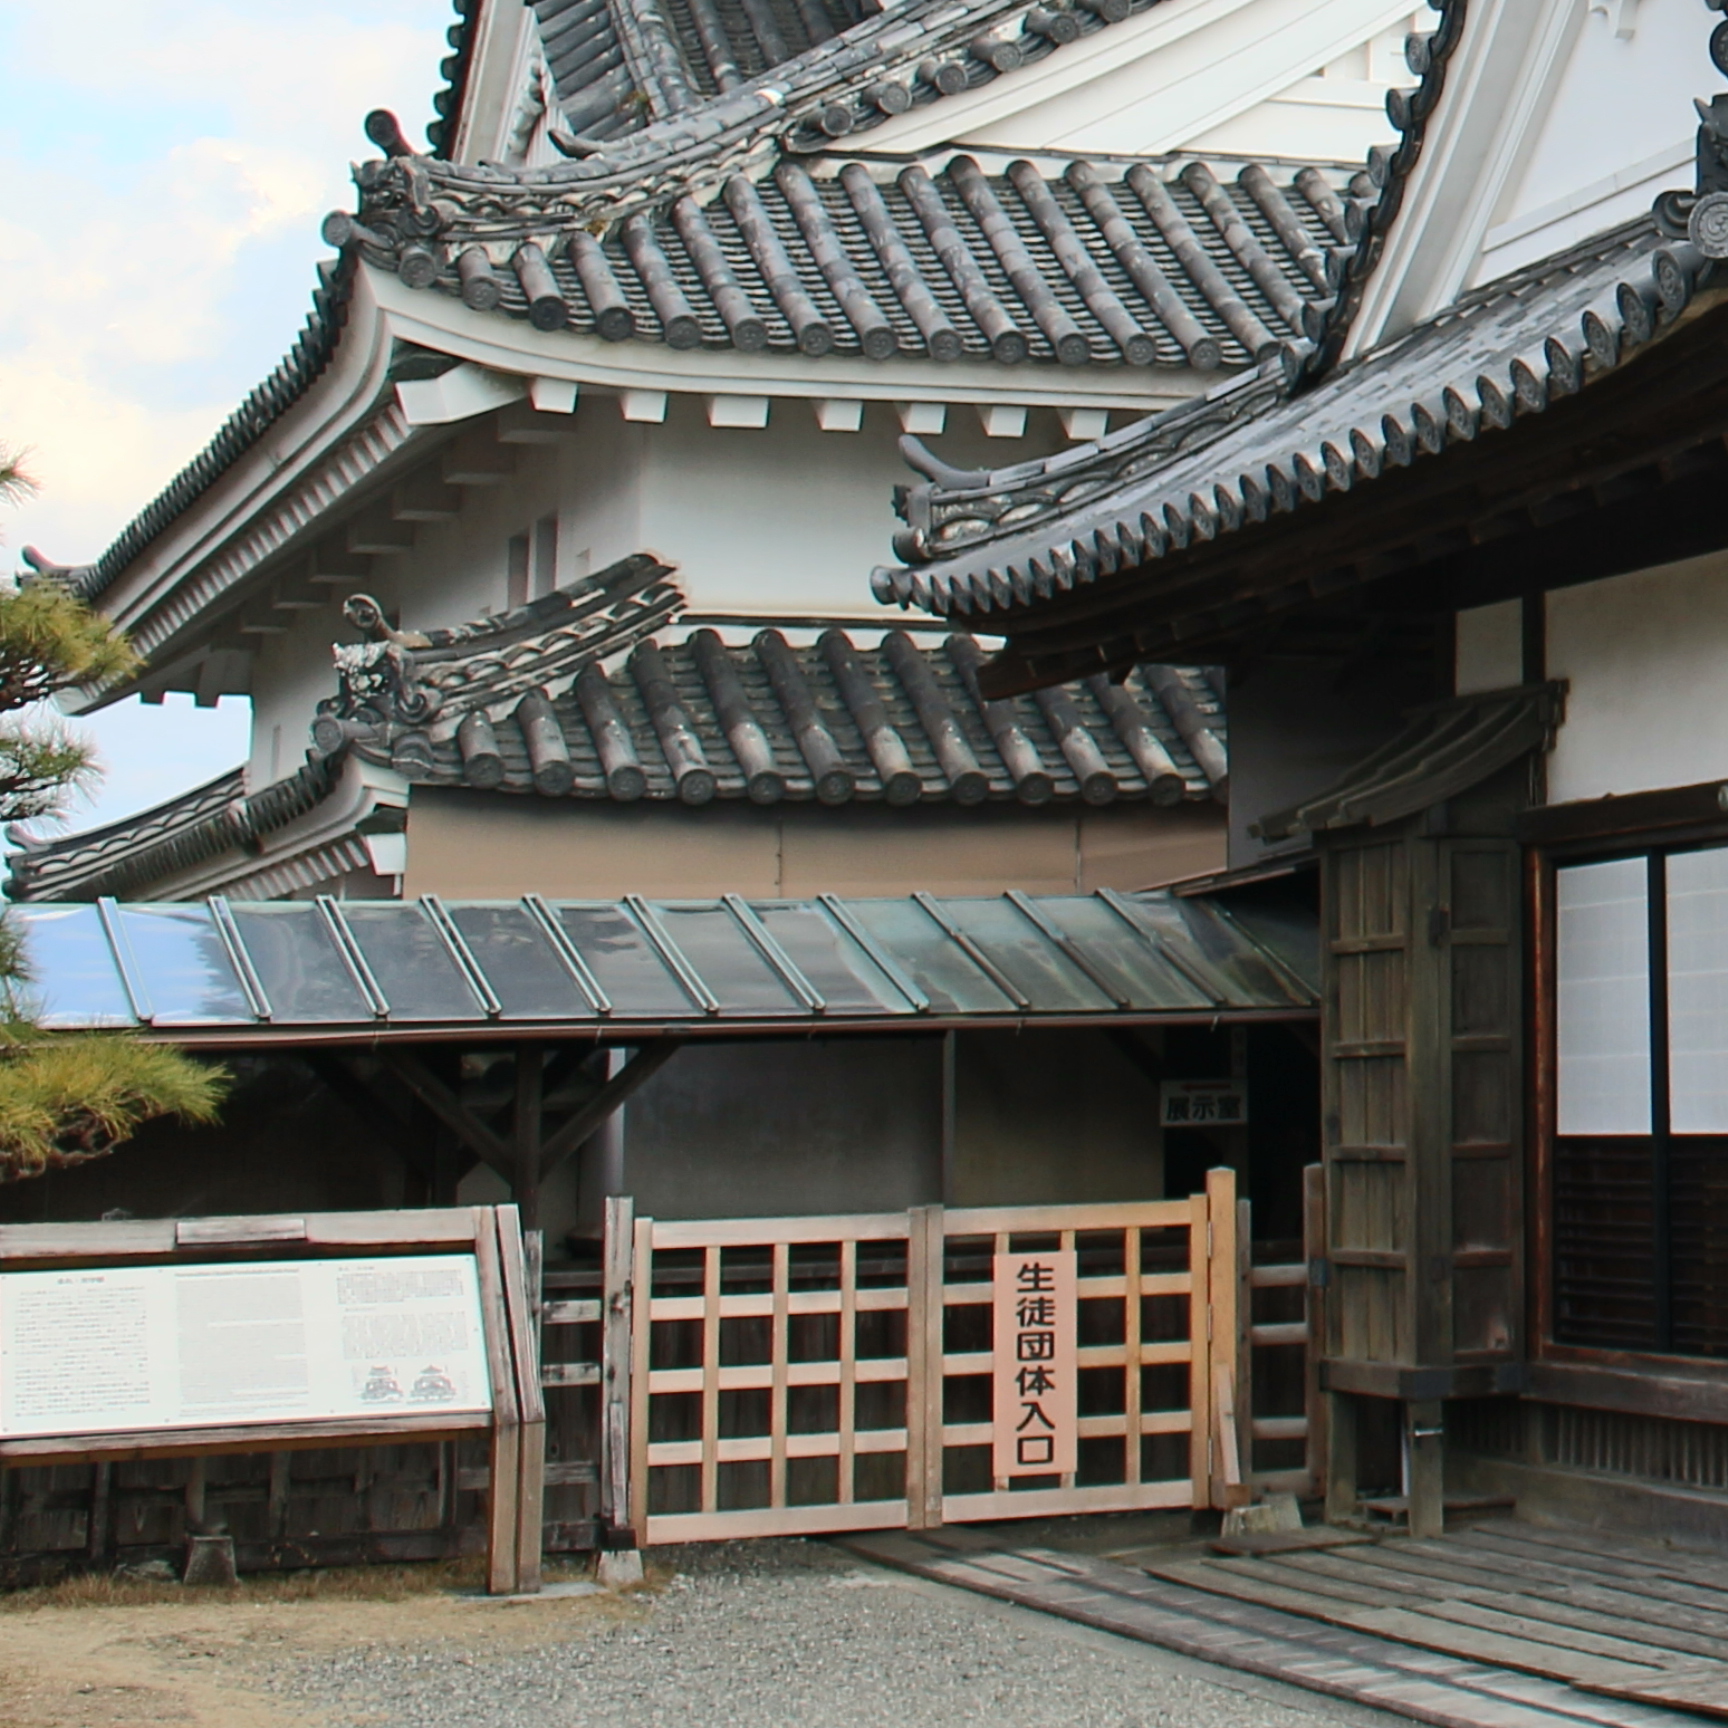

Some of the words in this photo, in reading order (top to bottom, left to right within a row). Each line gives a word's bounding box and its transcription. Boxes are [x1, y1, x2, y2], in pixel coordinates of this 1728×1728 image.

[1166, 1095, 1242, 1121] 展示室
[1014, 1261, 1056, 1466] 生徒団体入口
